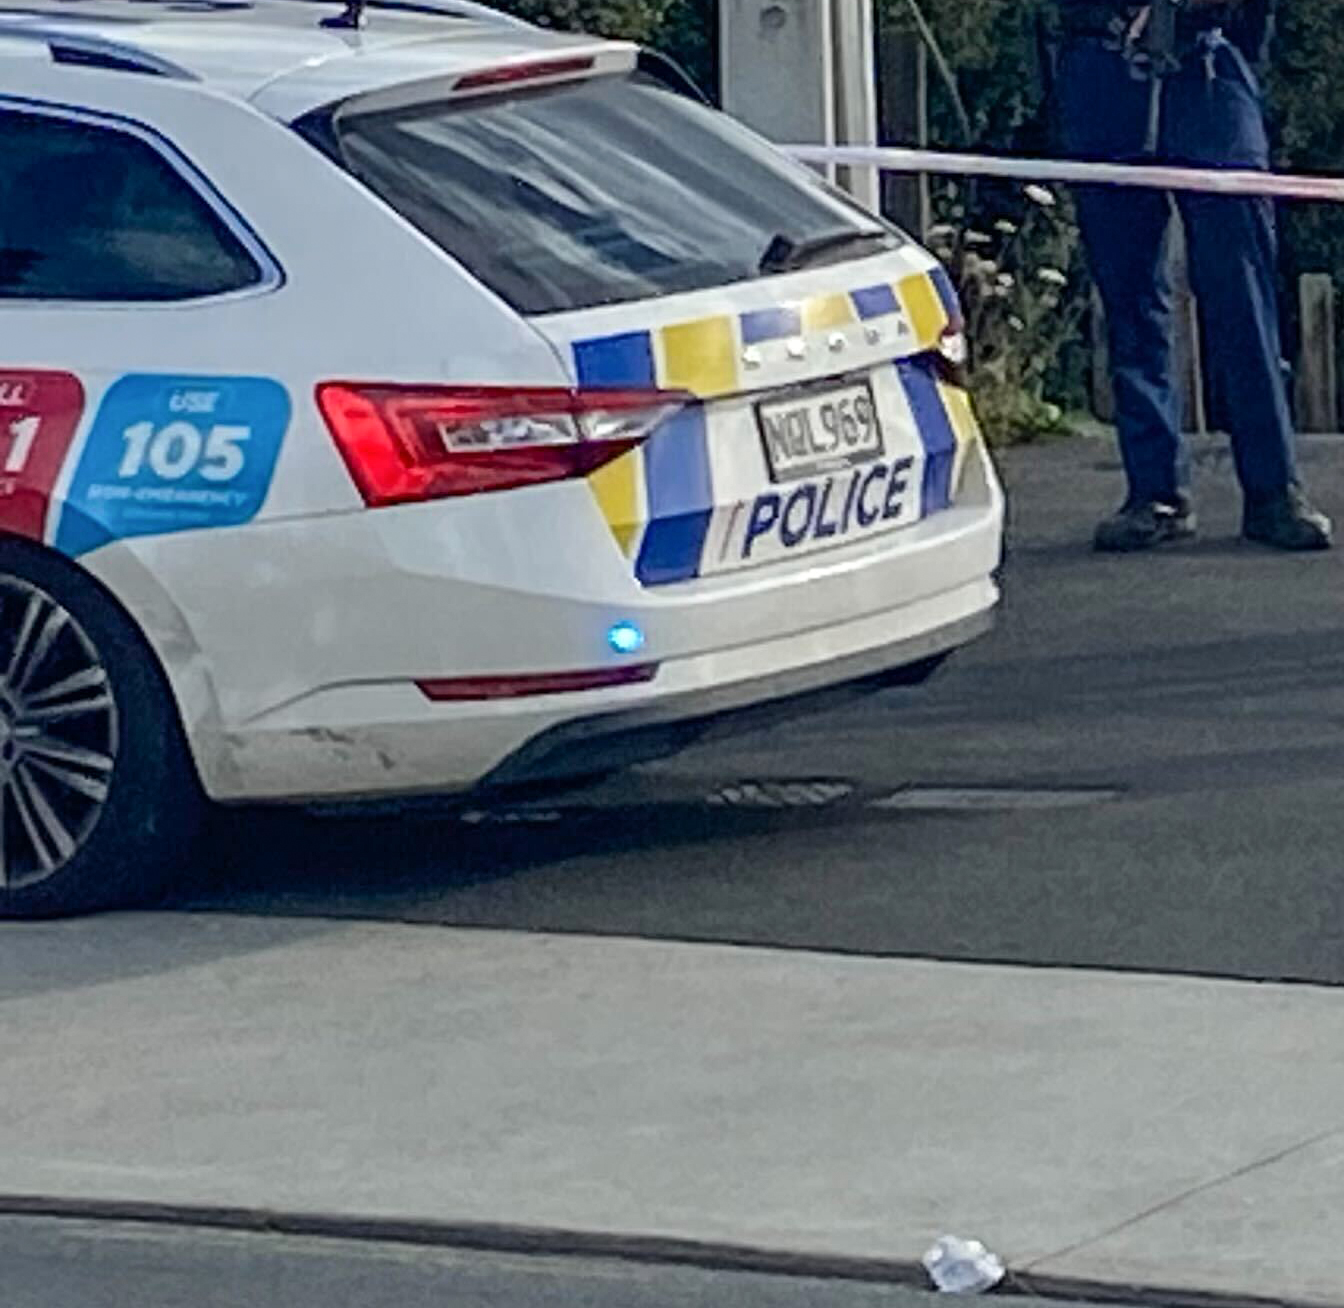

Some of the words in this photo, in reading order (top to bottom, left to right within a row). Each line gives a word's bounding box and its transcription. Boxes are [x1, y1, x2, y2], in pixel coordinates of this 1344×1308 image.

[169, 389, 220, 412] USE
[118, 421, 251, 482] 105
[741, 455, 915, 560] POLICE
